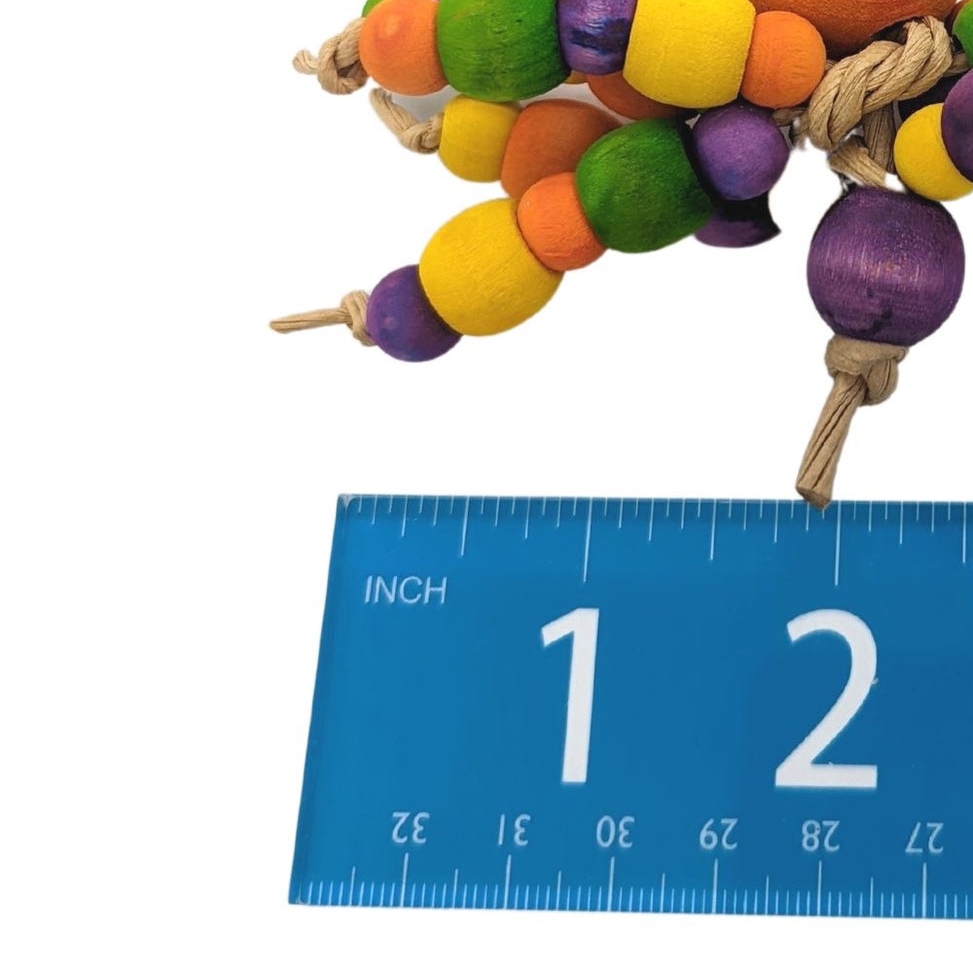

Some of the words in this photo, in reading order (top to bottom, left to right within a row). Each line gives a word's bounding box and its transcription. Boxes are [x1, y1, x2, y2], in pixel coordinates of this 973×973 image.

[364, 574, 448, 605] INCH
[541, 606, 600, 784] 1
[774, 608, 878, 789] 2
[391, 811, 430, 844] 32
[498, 814, 531, 846] 31
[595, 815, 635, 848] 30
[699, 818, 738, 850] 29
[801, 820, 841, 852] 28
[905, 823, 944, 854] 27
